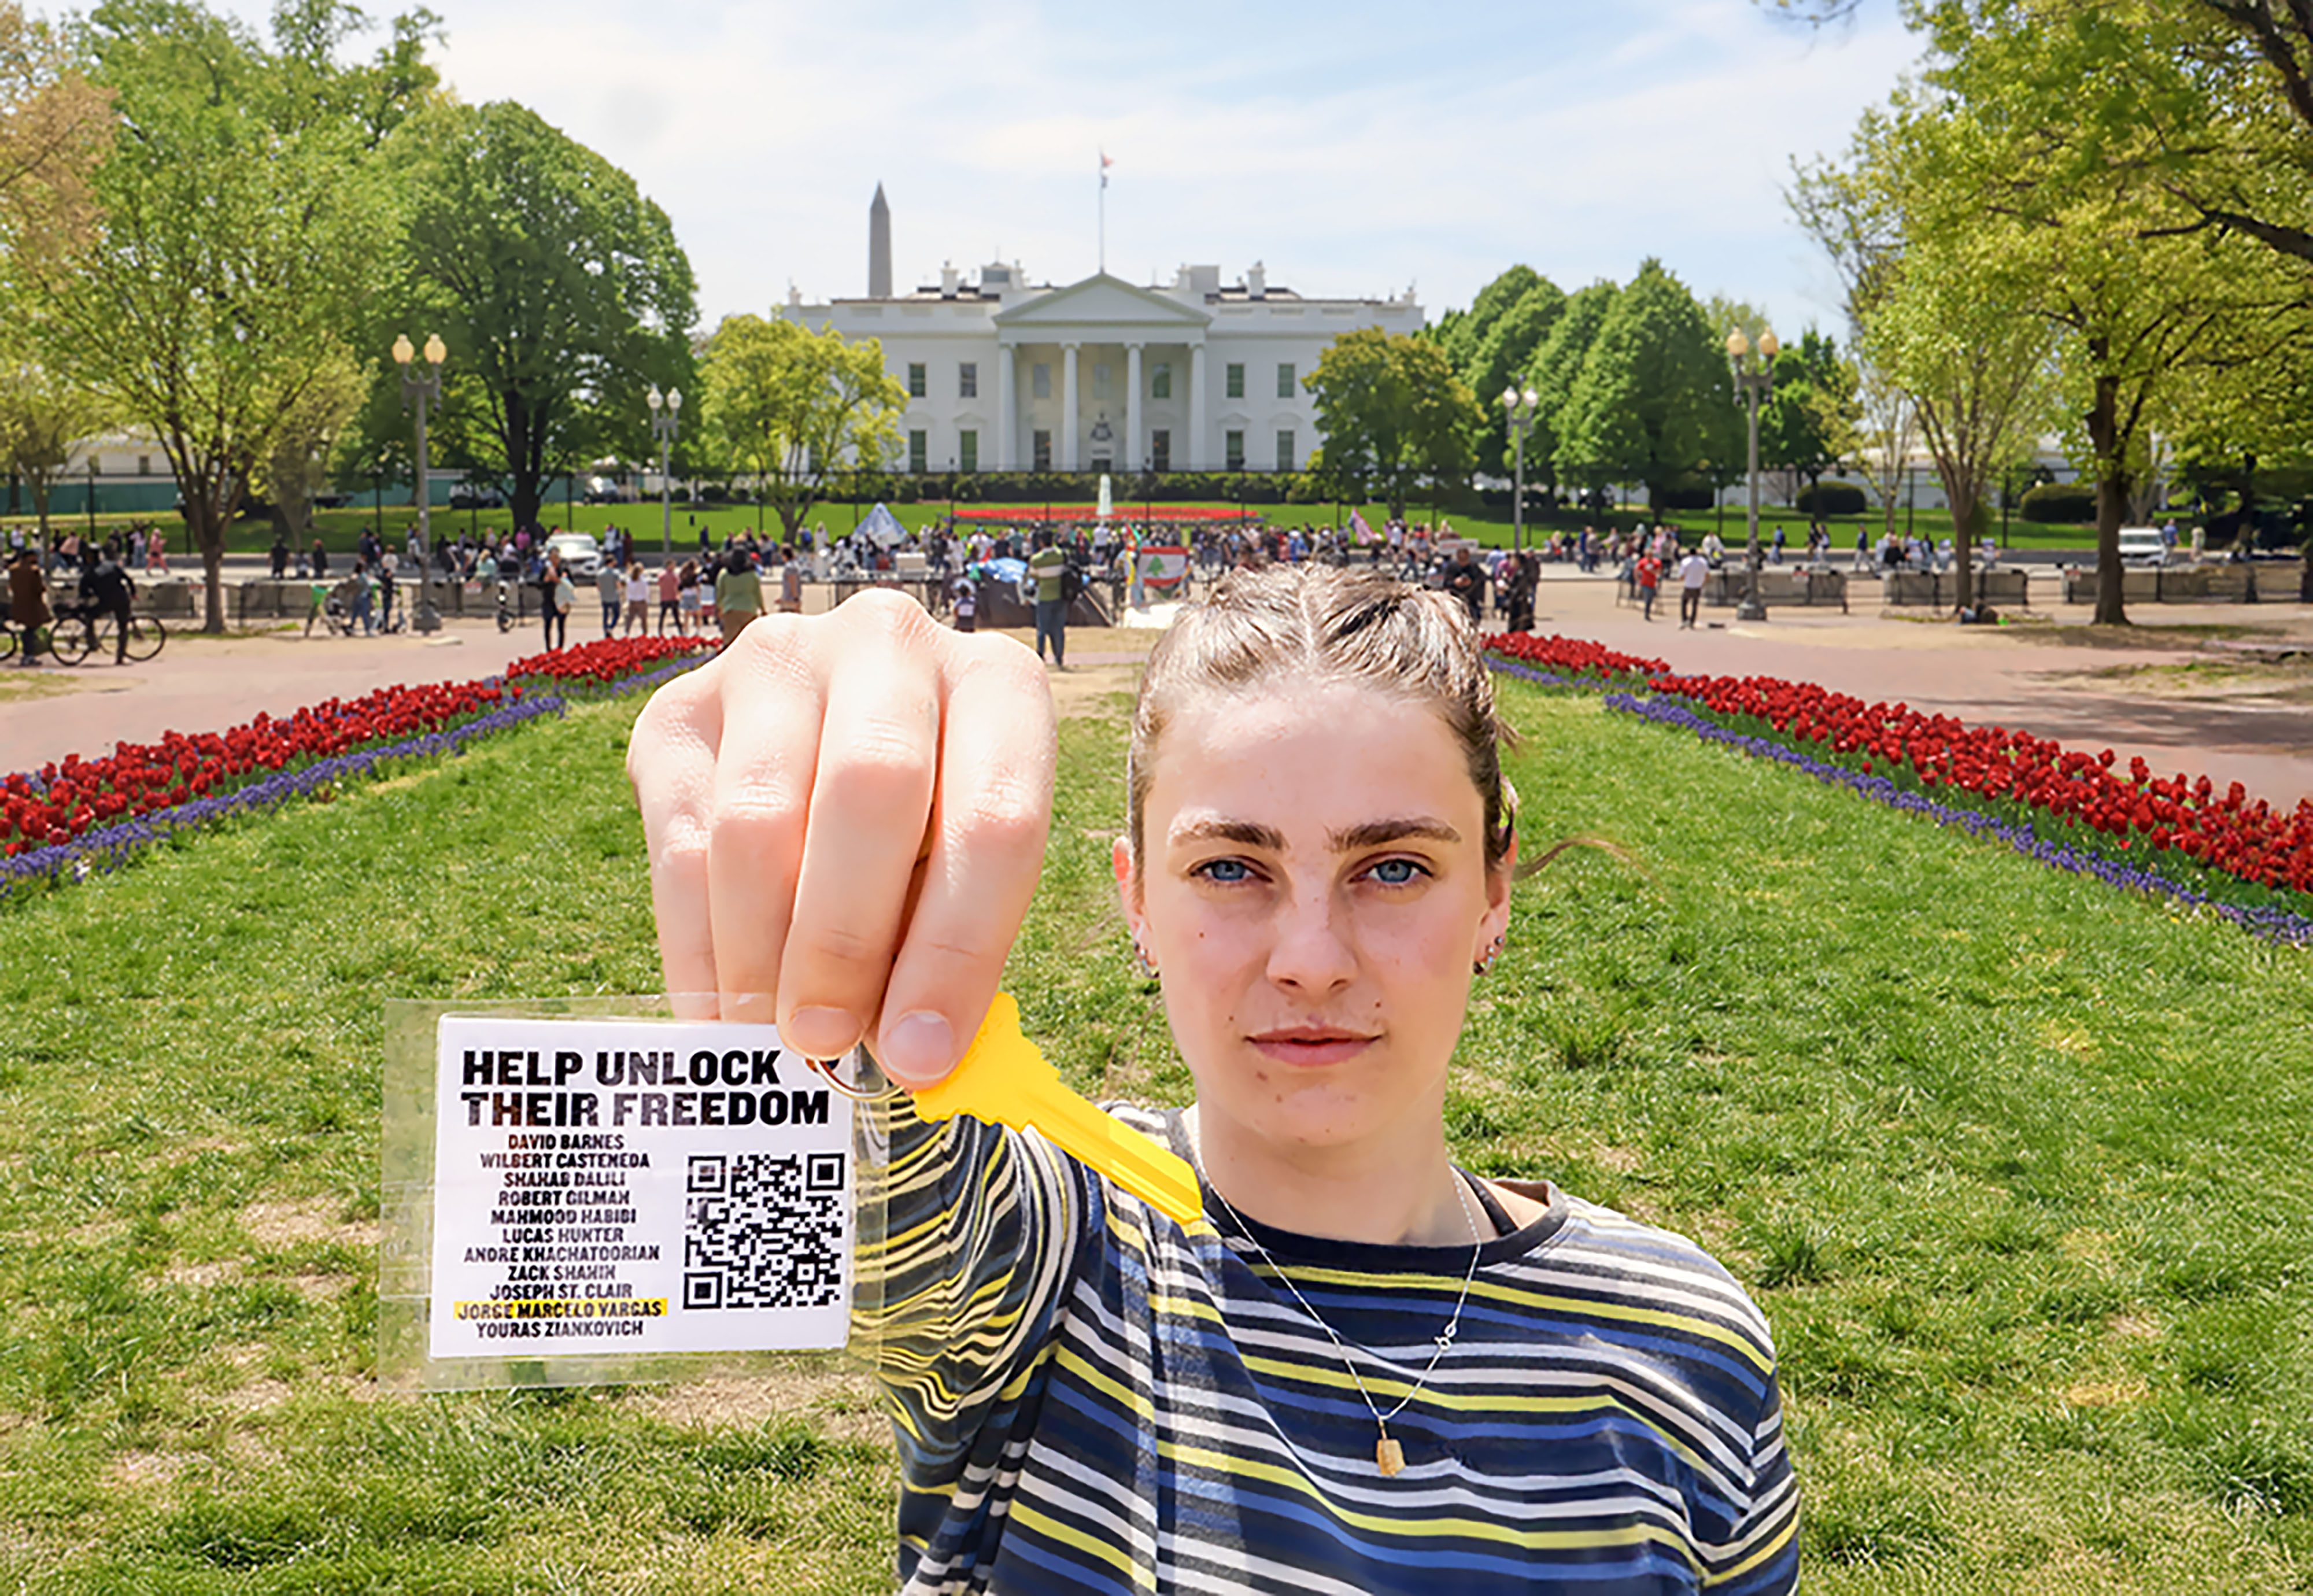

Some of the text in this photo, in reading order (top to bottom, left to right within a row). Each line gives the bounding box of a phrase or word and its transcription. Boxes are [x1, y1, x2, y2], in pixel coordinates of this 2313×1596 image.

[462, 1050, 781, 1087] HELP UNLOCK
[460, 1090, 829, 1127] THEIR FREEDOM
[508, 1133, 625, 1150] DAVID BARNES
[480, 1153, 553, 1169] WILBERT
[504, 1172, 626, 1188] SHAHAB DALILI
[498, 1189, 630, 1206] ROBERT GILMAN
[490, 1208, 637, 1225] MAHMOOD HABIBI
[502, 1227, 624, 1244] LUCAS HUNTER
[464, 1245, 660, 1263] ANDRE KHACHATOORIAN
[508, 1265, 616, 1282] ZACK SHAHIN
[490, 1283, 632, 1301] JOSEPH ST. CLAIR
[458, 1301, 662, 1320] JORGE MARCELO VARGAS
[476, 1320, 644, 1338] YOURAS ZIANKOVICH
